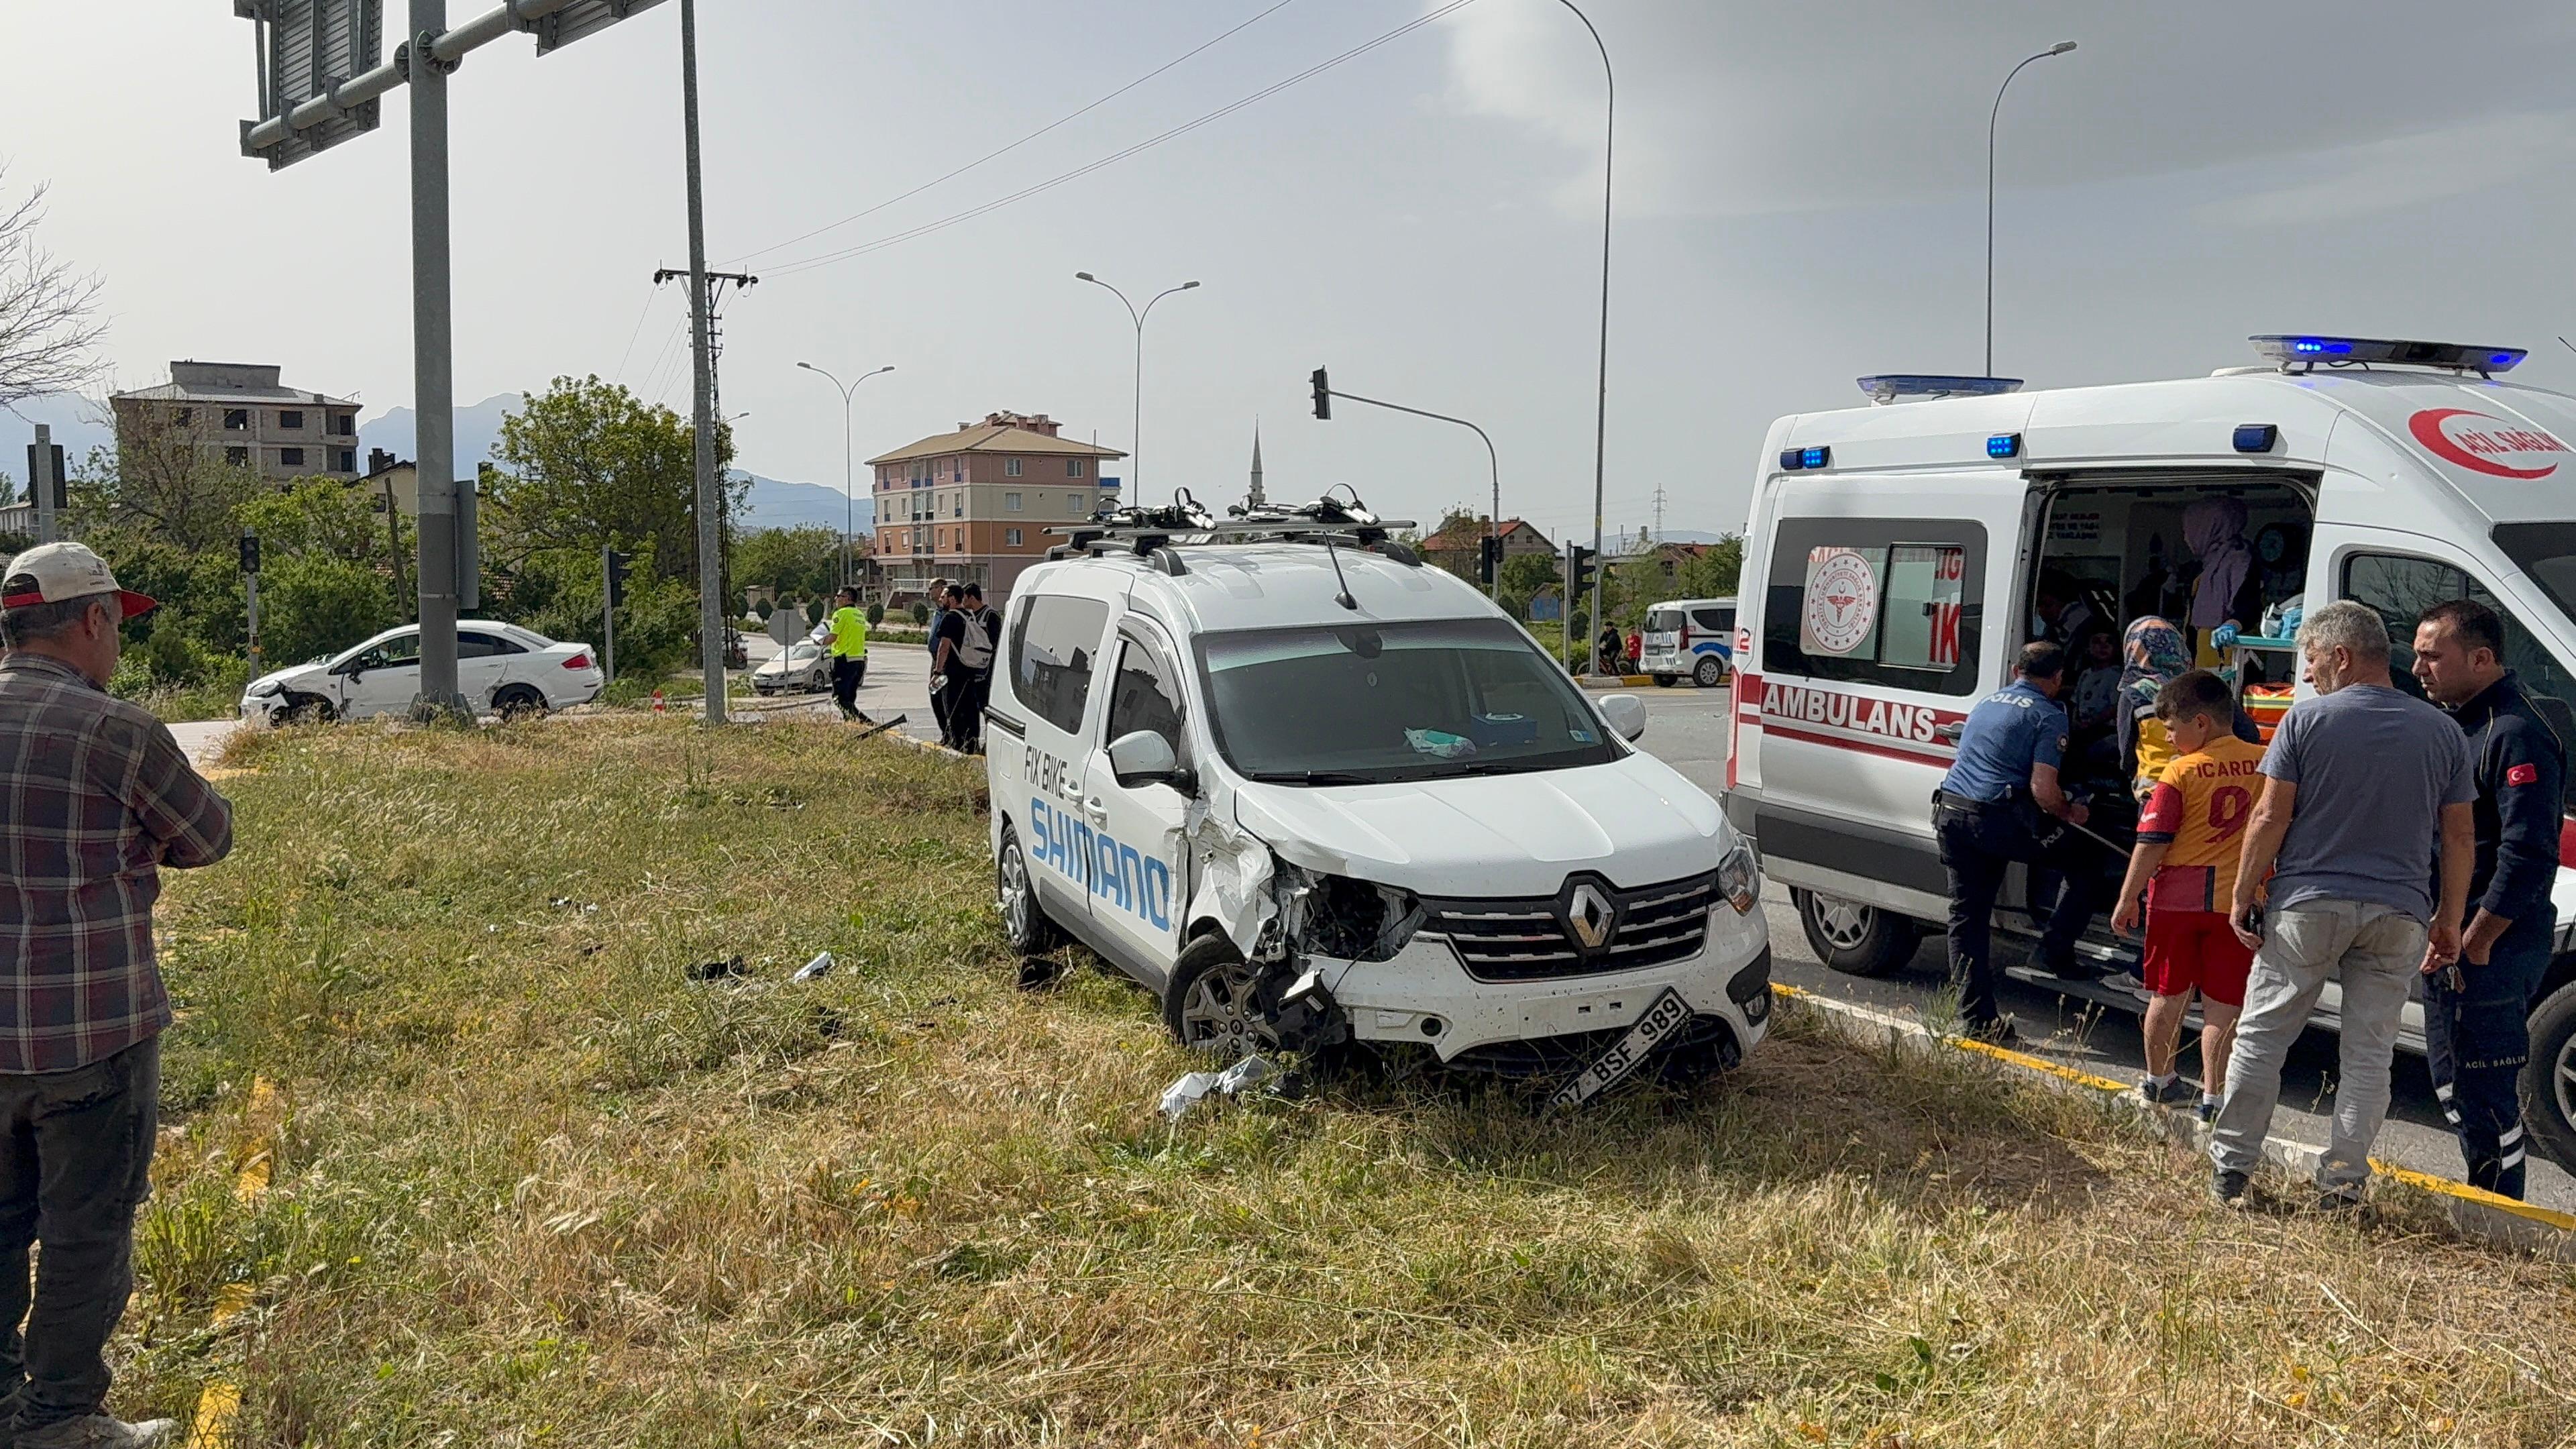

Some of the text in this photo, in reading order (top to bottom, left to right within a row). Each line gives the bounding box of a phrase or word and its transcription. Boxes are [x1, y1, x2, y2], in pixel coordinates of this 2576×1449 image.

[1762, 683, 1936, 743] AMBULANS
[1024, 745, 1068, 800] FIX BIKE
[2204, 785, 2252, 844] 9
[1030, 796, 1169, 932] SHIMANO
[1592, 1040, 1631, 1083] BSF
[1640, 998, 1681, 1041] 989
